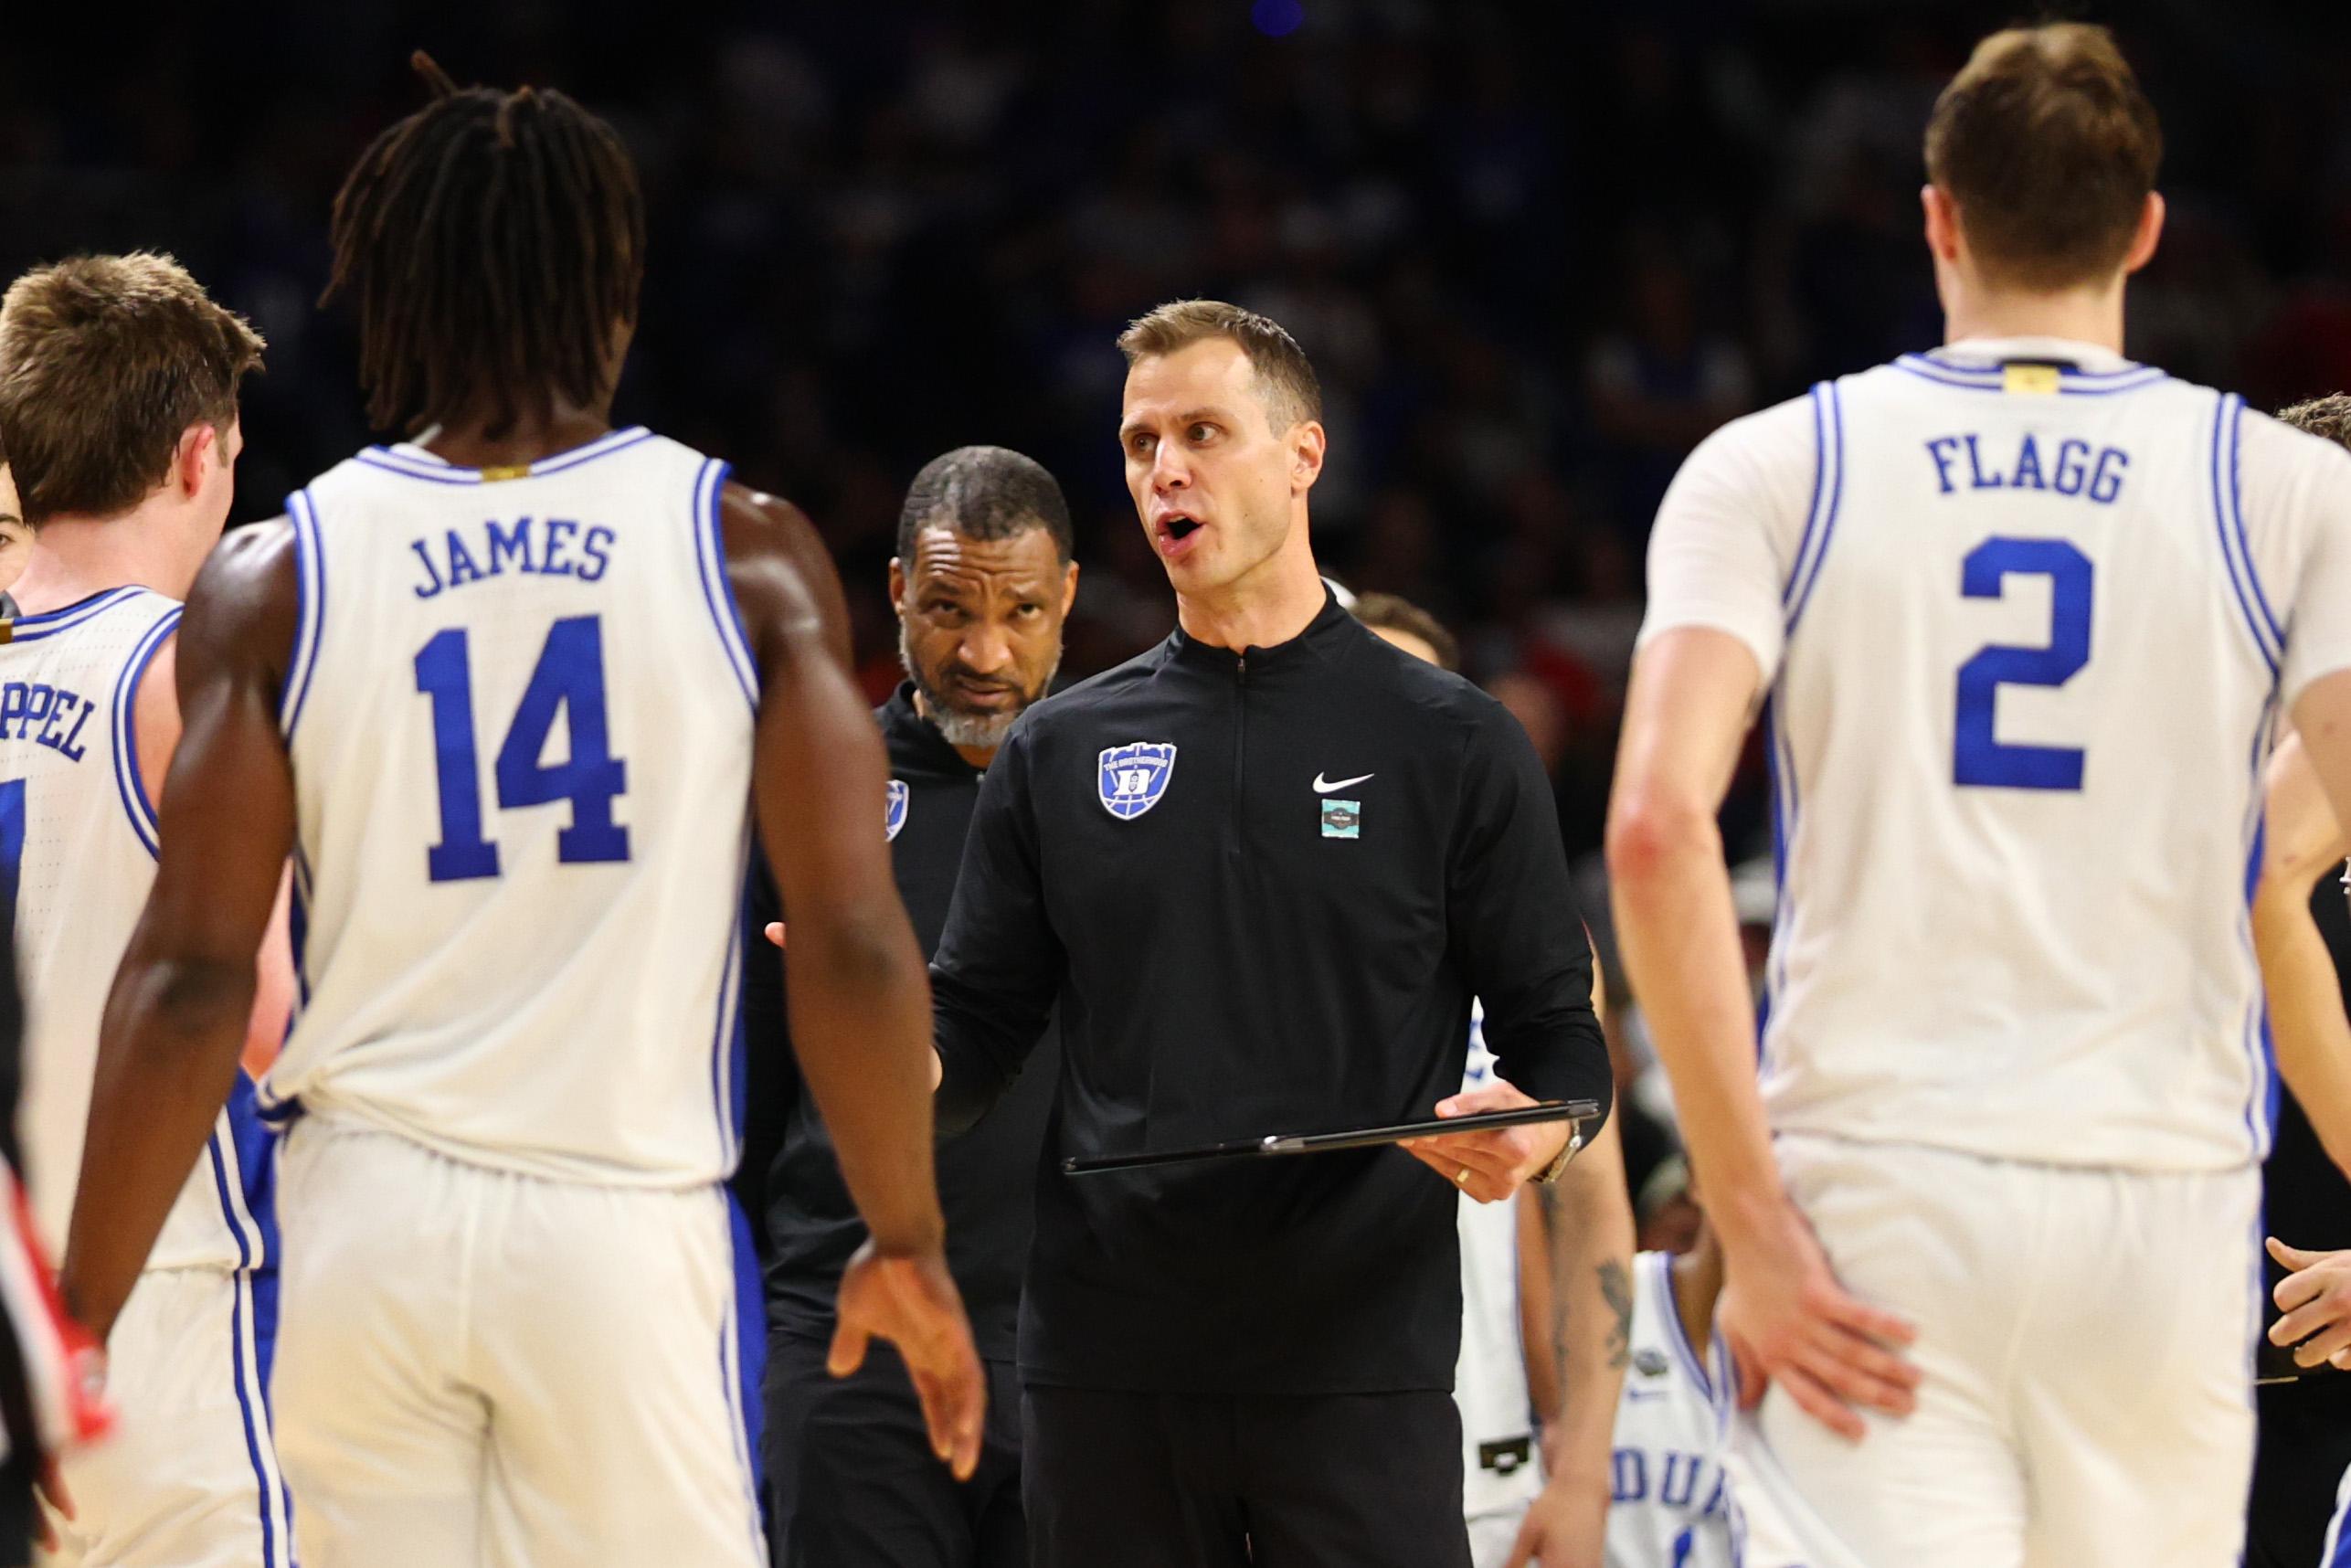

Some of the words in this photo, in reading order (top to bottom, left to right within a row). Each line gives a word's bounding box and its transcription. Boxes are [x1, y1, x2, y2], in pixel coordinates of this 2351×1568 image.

[1925, 432, 2130, 504] FLAGG
[410, 516, 616, 599] JAMES
[1954, 535, 2093, 791] 2
[414, 614, 630, 883] 14
